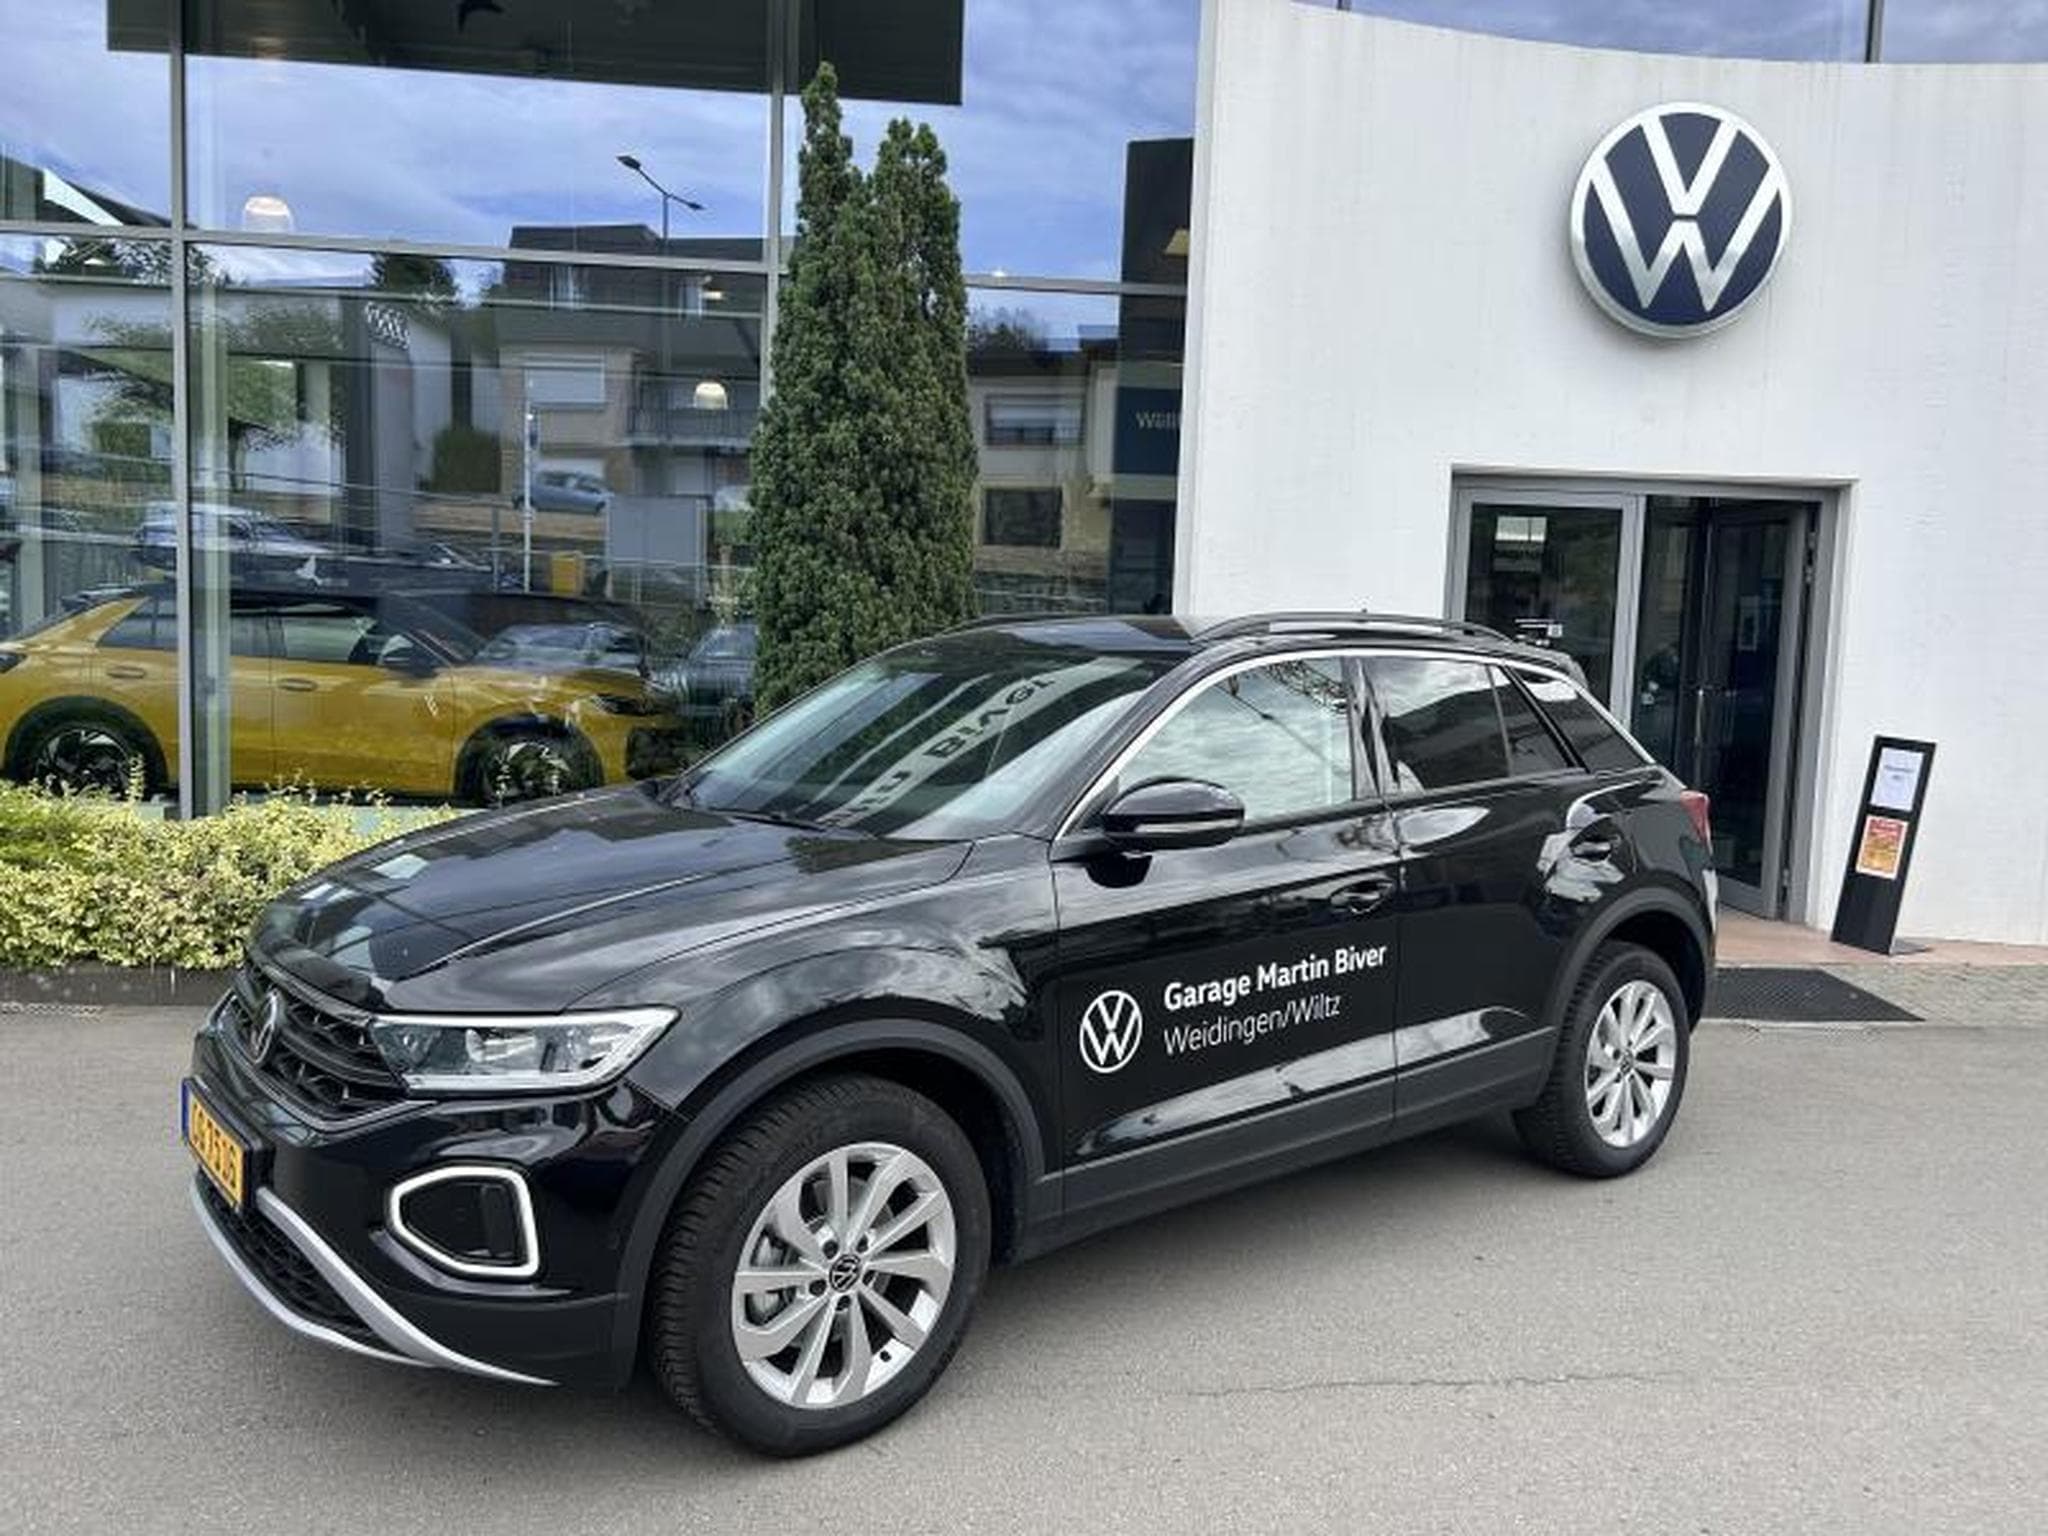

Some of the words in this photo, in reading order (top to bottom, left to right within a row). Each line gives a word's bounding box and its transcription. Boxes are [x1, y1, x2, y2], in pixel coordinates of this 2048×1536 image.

[1577, 105, 1790, 328] VW
[1164, 981, 1251, 1012] Garage
[1256, 953, 1329, 992] Martin
[1335, 945, 1388, 975] Biver
[1081, 990, 1141, 1071] VW
[1164, 993, 1341, 1055] Weidingen/Wiltz
